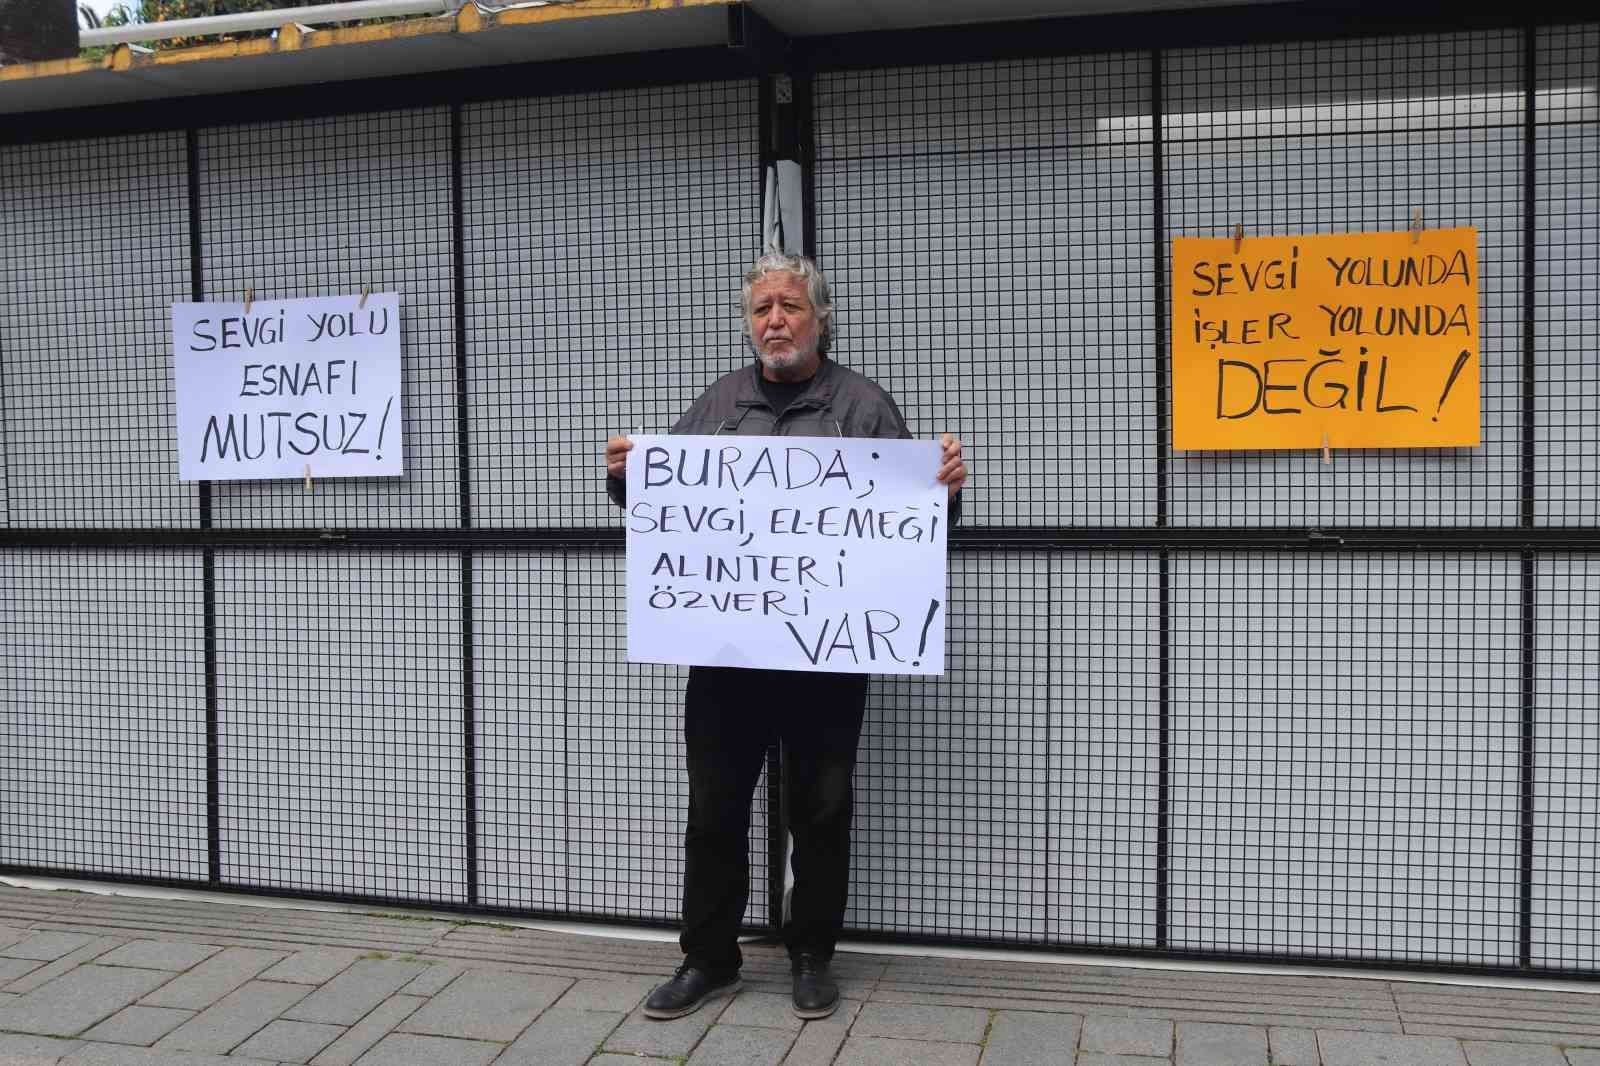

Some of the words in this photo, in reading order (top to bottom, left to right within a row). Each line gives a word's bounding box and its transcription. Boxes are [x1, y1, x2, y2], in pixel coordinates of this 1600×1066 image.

[1192, 245, 1298, 296] SEVGİ
[1326, 249, 1471, 287] YOLUNDA
[190, 308, 285, 352] SEVGİ
[306, 307, 389, 342] YOLU
[1194, 307, 1300, 350] İŞLER
[1318, 303, 1471, 337] YOLUNDA
[239, 360, 358, 397] ESNAFI
[200, 395, 394, 463] MUTSUZ!
[651, 549, 847, 588] ALINTERİ
[648, 585, 811, 616] ÖZVERİ
